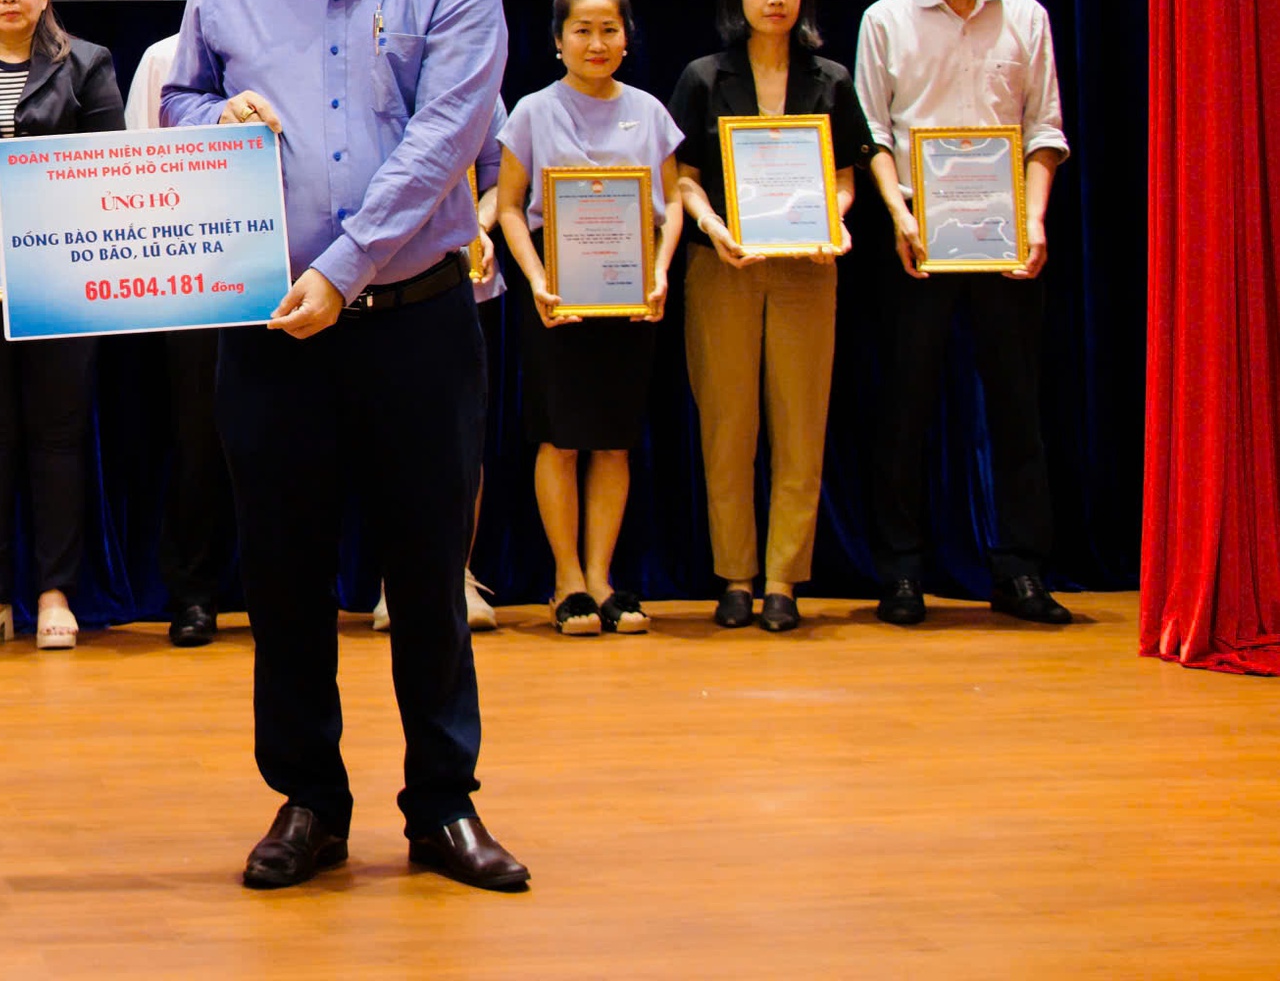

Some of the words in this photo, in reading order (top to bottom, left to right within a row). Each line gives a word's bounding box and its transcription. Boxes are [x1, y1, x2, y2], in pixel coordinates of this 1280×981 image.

[8, 150, 49, 165] ĐOÀN
[54, 148, 105, 162] THANH
[109, 144, 142, 158] NIÊN
[146, 144, 171, 158] ĐẠI
[175, 142, 204, 156] HỌC
[208, 140, 243, 152] KINH
[247, 135, 264, 149] TẾ
[47, 167, 98, 181] THÀNH
[102, 161, 132, 177] PHỐ
[135, 160, 156, 174] HỒ
[160, 158, 184, 173] CHÍ
[188, 159, 227, 171] MINH
[101, 190, 144, 211] ỦNG
[149, 187, 180, 211] HỘ
[64, 228, 98, 245] BÀO
[103, 223, 147, 242] KHẮC
[153, 223, 194, 239] PHỤC
[199, 218, 241, 237] THIỆT
[247, 218, 274, 234] HẠI
[71, 248, 94, 262] DO
[99, 245, 137, 261] BÃO,
[143, 241, 160, 258] LŨ
[166, 240, 197, 256] GÂY
[202, 241, 224, 253] RA
[85, 273, 204, 301] 60.504.181
